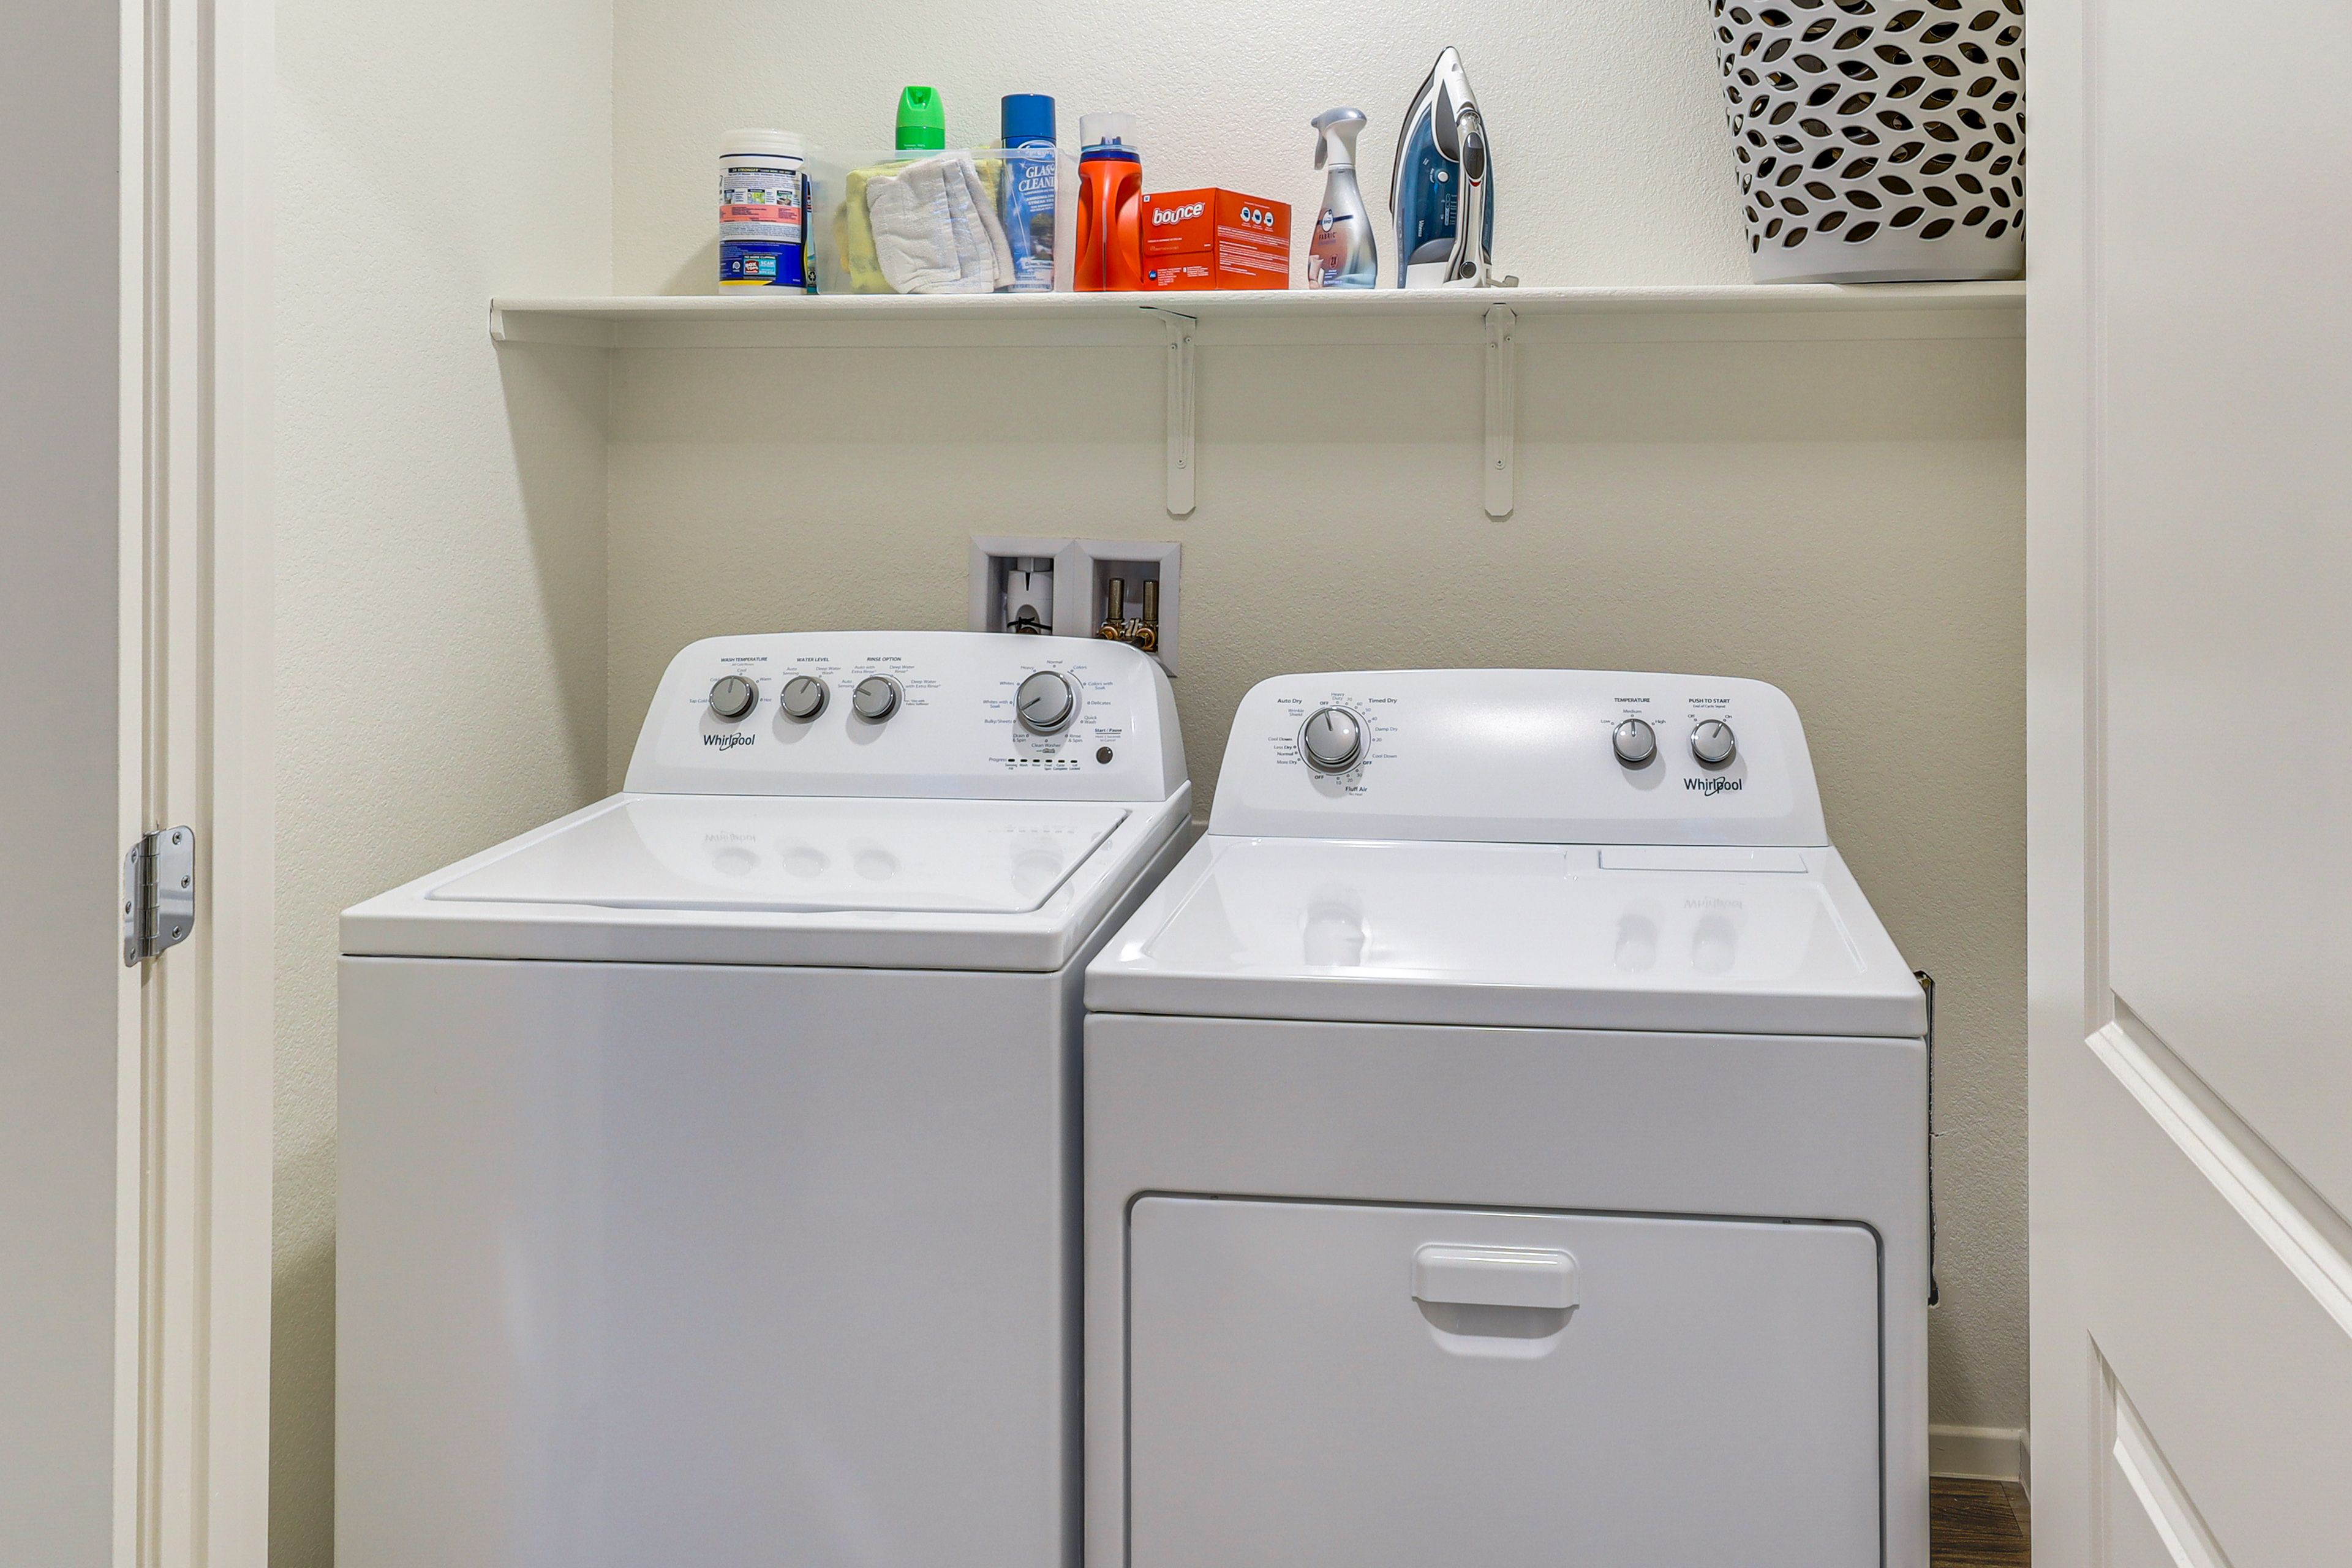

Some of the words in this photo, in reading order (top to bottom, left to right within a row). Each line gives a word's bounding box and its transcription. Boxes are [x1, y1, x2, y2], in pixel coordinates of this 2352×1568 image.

[1153, 203, 1204, 225] bounce
[703, 733, 756, 750] Whirlpool
[1683, 777, 1743, 796] Whirlpool
